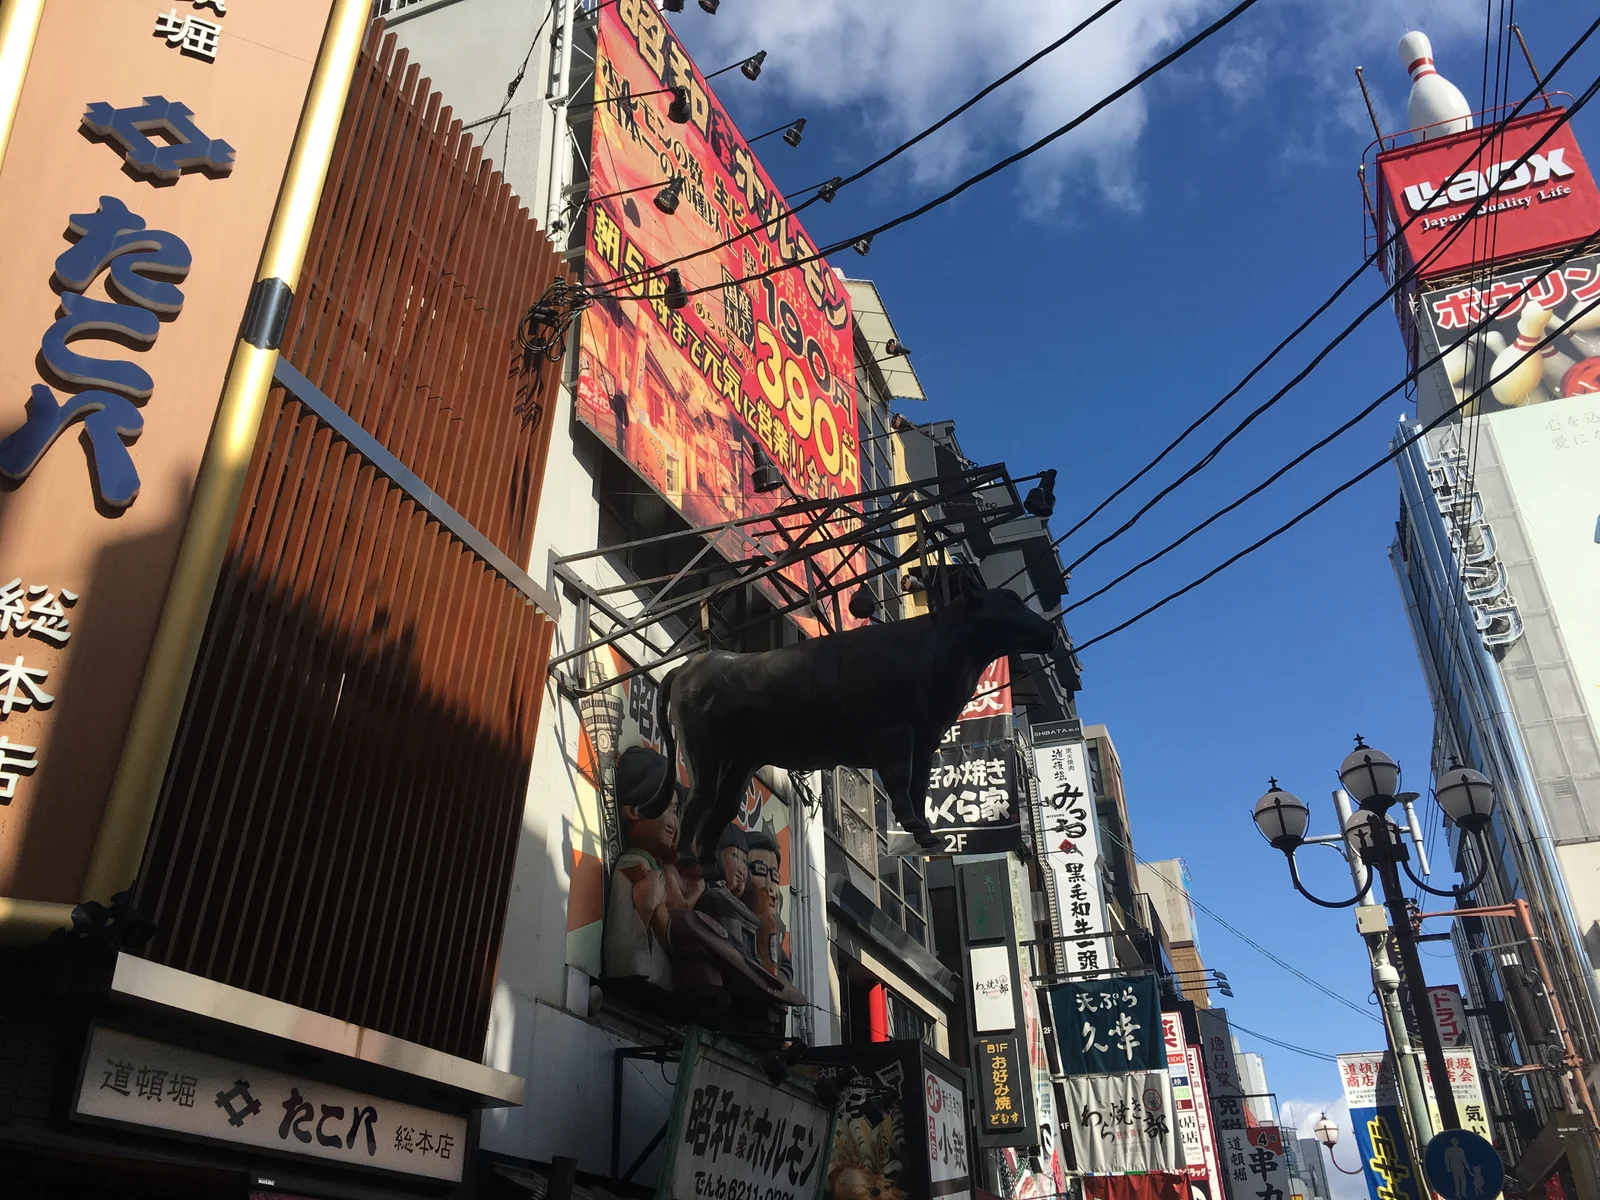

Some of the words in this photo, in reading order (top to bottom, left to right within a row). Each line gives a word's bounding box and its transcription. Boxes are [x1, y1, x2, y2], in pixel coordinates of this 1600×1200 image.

[155, 0, 226, 60] 堀
[1538, 185, 1572, 203] Life
[944, 834, 967, 852] 2F
[1075, 986, 1138, 1013] 天ぷら
[1433, 993, 1459, 1042] ドラゴ
[1081, 1013, 1141, 1061] 久幸
[100, 1058, 198, 1108] 道頓堀
[991, 1055, 1012, 1112] お好み焼
[393, 1125, 455, 1160] 総本店
[1226, 1136, 1248, 1182] 道頓堀
